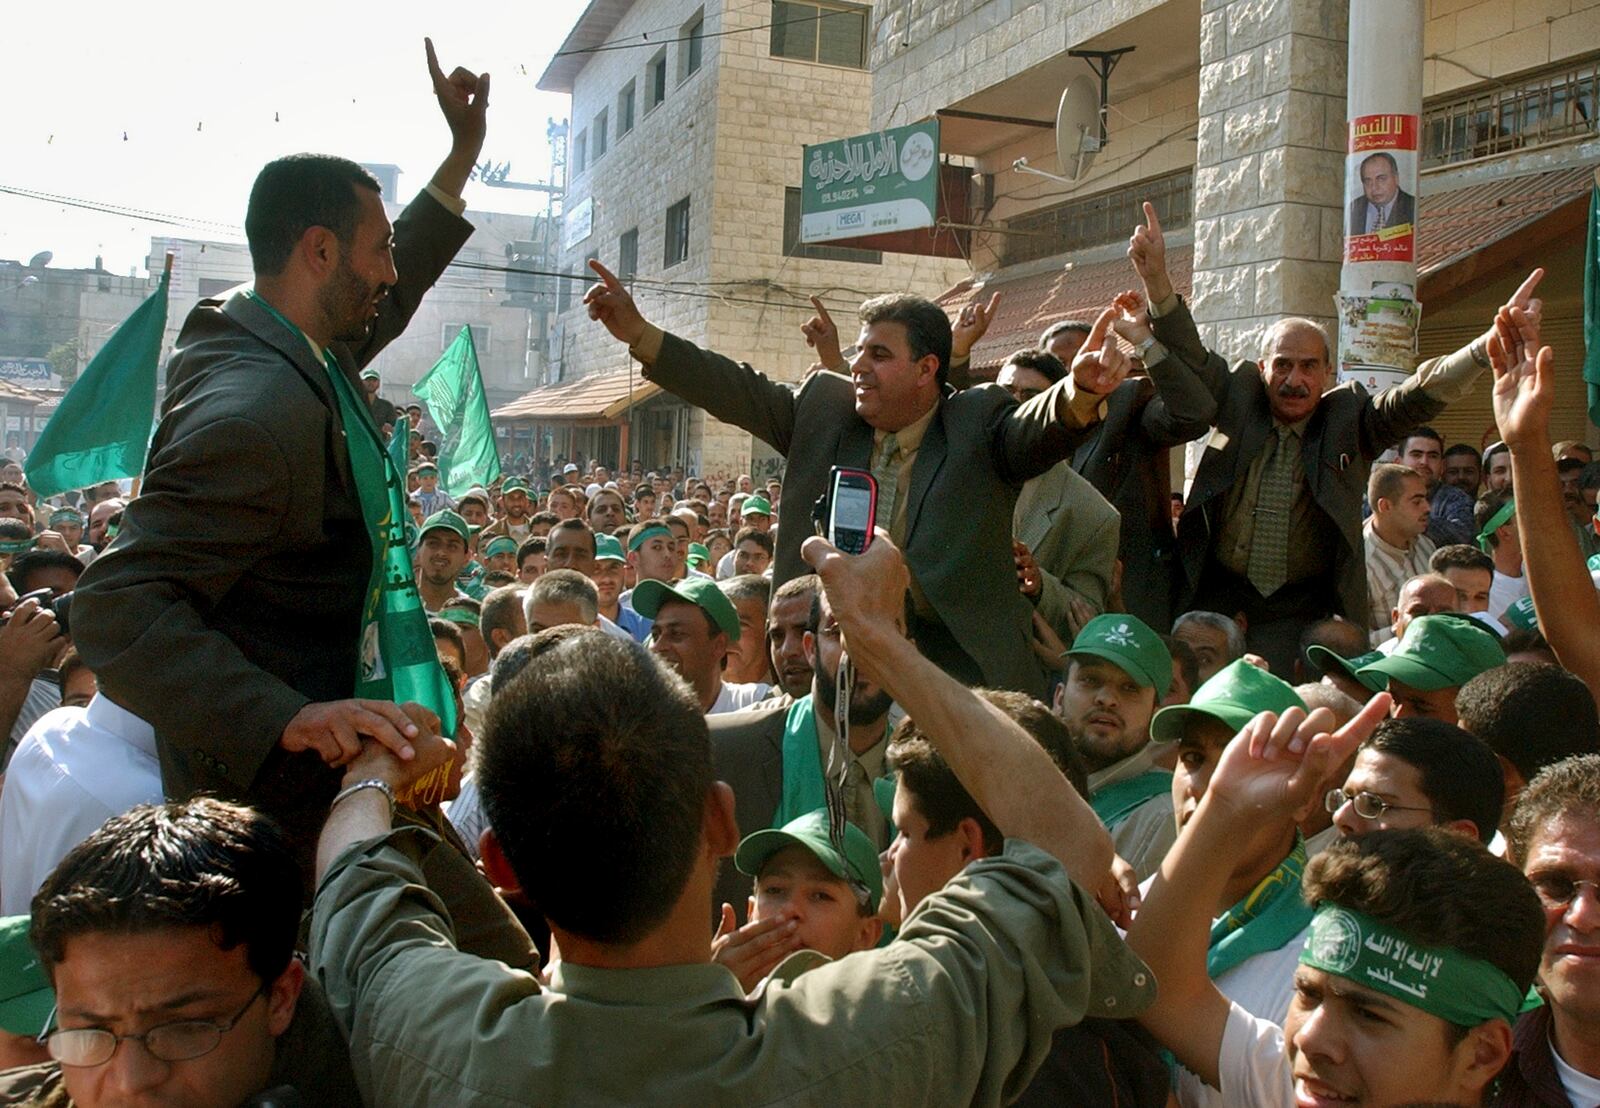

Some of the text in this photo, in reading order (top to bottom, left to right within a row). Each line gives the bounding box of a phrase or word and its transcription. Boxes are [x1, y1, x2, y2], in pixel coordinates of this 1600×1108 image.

[1394, 116, 1402, 134] لا
[840, 212, 861, 225] MEGA
[1364, 932, 1443, 979] لا إله إلا الله
